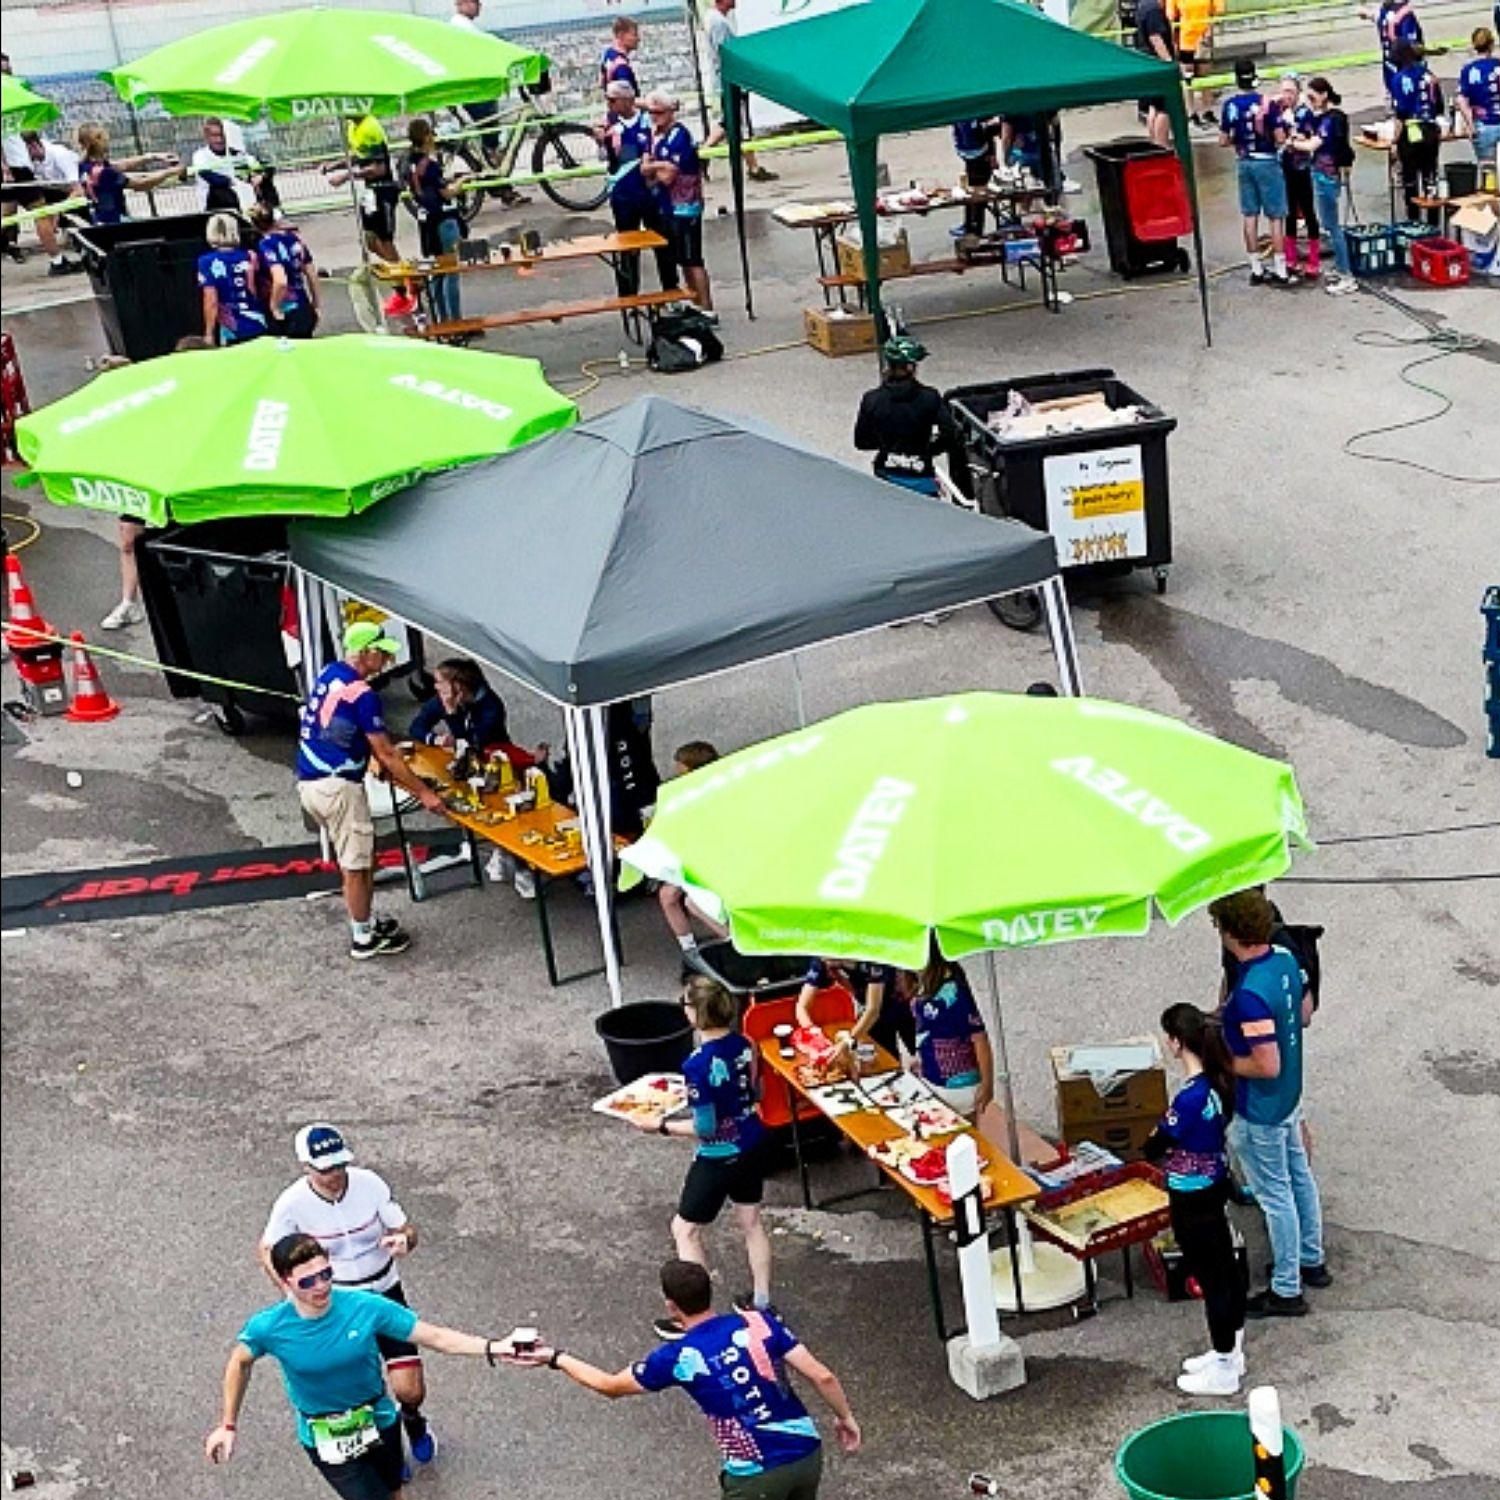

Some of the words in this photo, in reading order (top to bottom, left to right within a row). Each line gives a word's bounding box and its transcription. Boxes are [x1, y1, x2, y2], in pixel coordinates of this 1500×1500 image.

[292, 97, 374, 117] DATEV
[242, 399, 290, 471] DATEV
[818, 775, 917, 900] DATEV
[1049, 754, 1214, 855] DATEV
[60, 870, 200, 901] bar
[981, 905, 1104, 948] DATEV
[721, 1346, 772, 1420] ROTH
